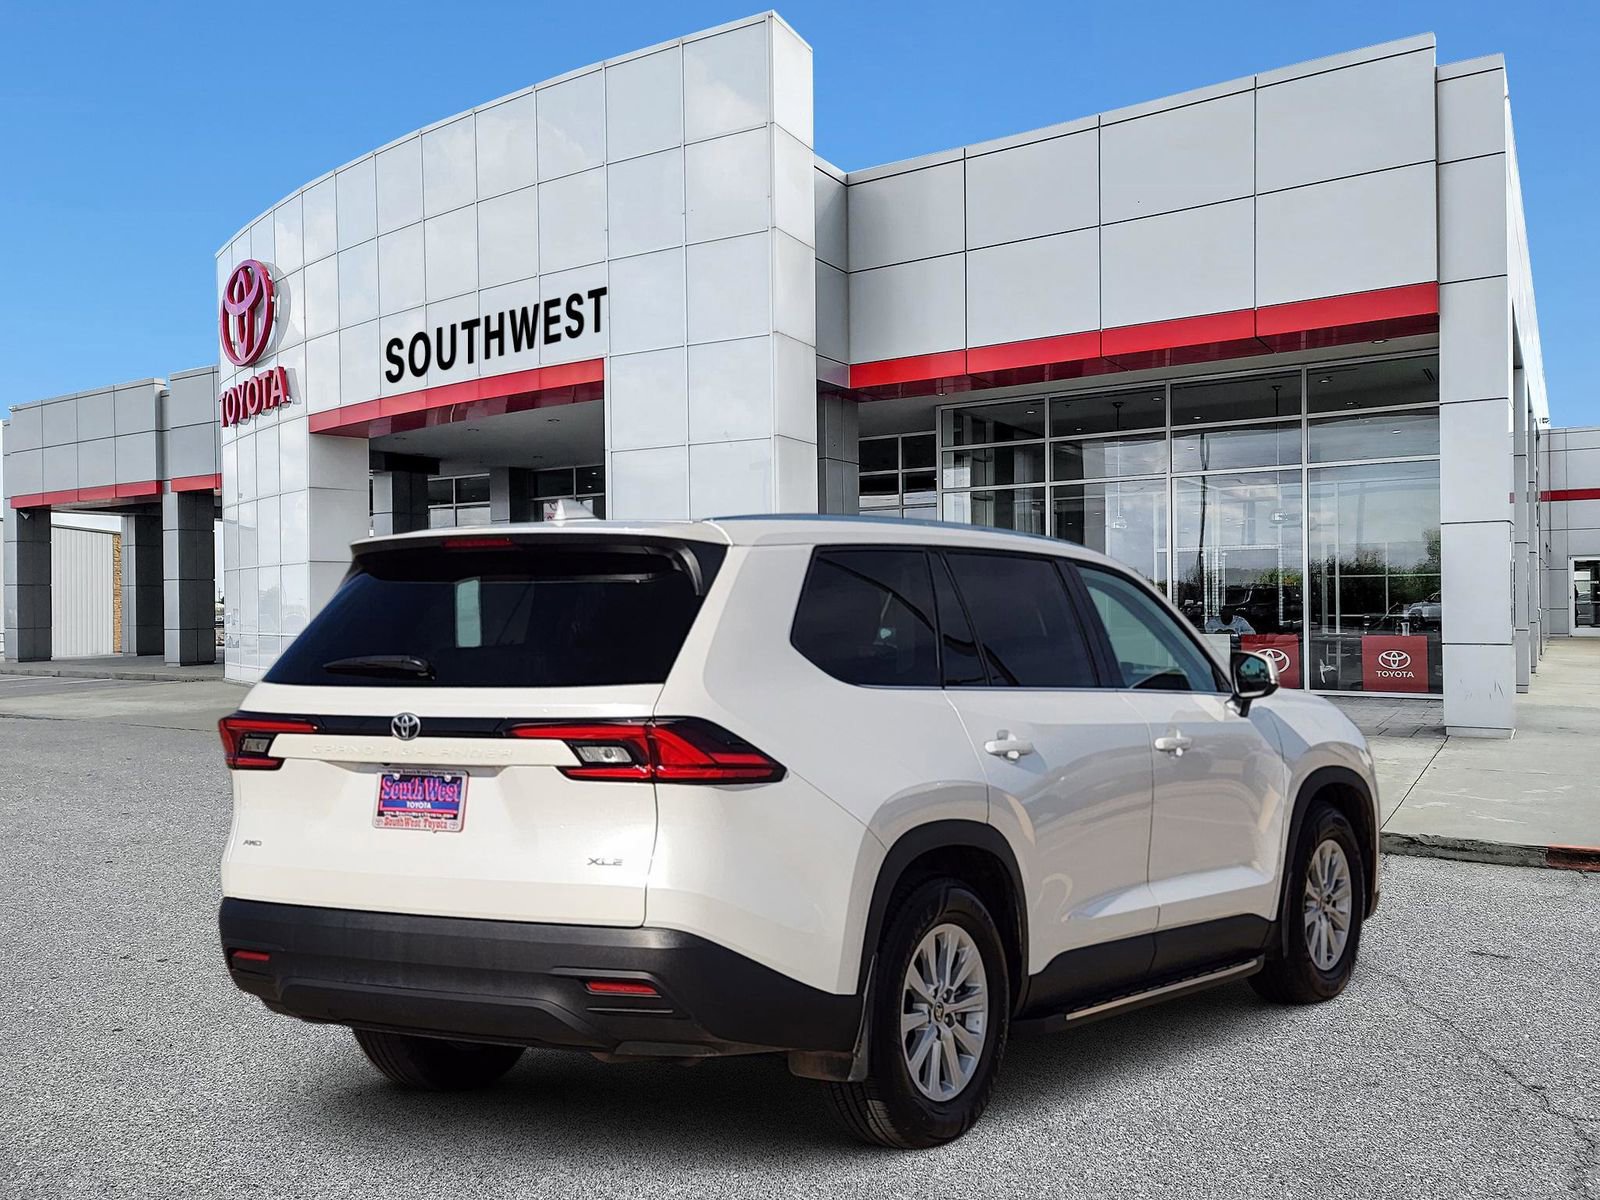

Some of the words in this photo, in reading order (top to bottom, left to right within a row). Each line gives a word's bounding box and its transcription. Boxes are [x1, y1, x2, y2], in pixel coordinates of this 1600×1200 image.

[385, 286, 608, 384] SOUTHWEST
[218, 366, 292, 428] TOYOTA
[1375, 670, 1415, 678] TOYOTA
[406, 801, 432, 809] TOYOTA
[586, 857, 624, 866] XLE
